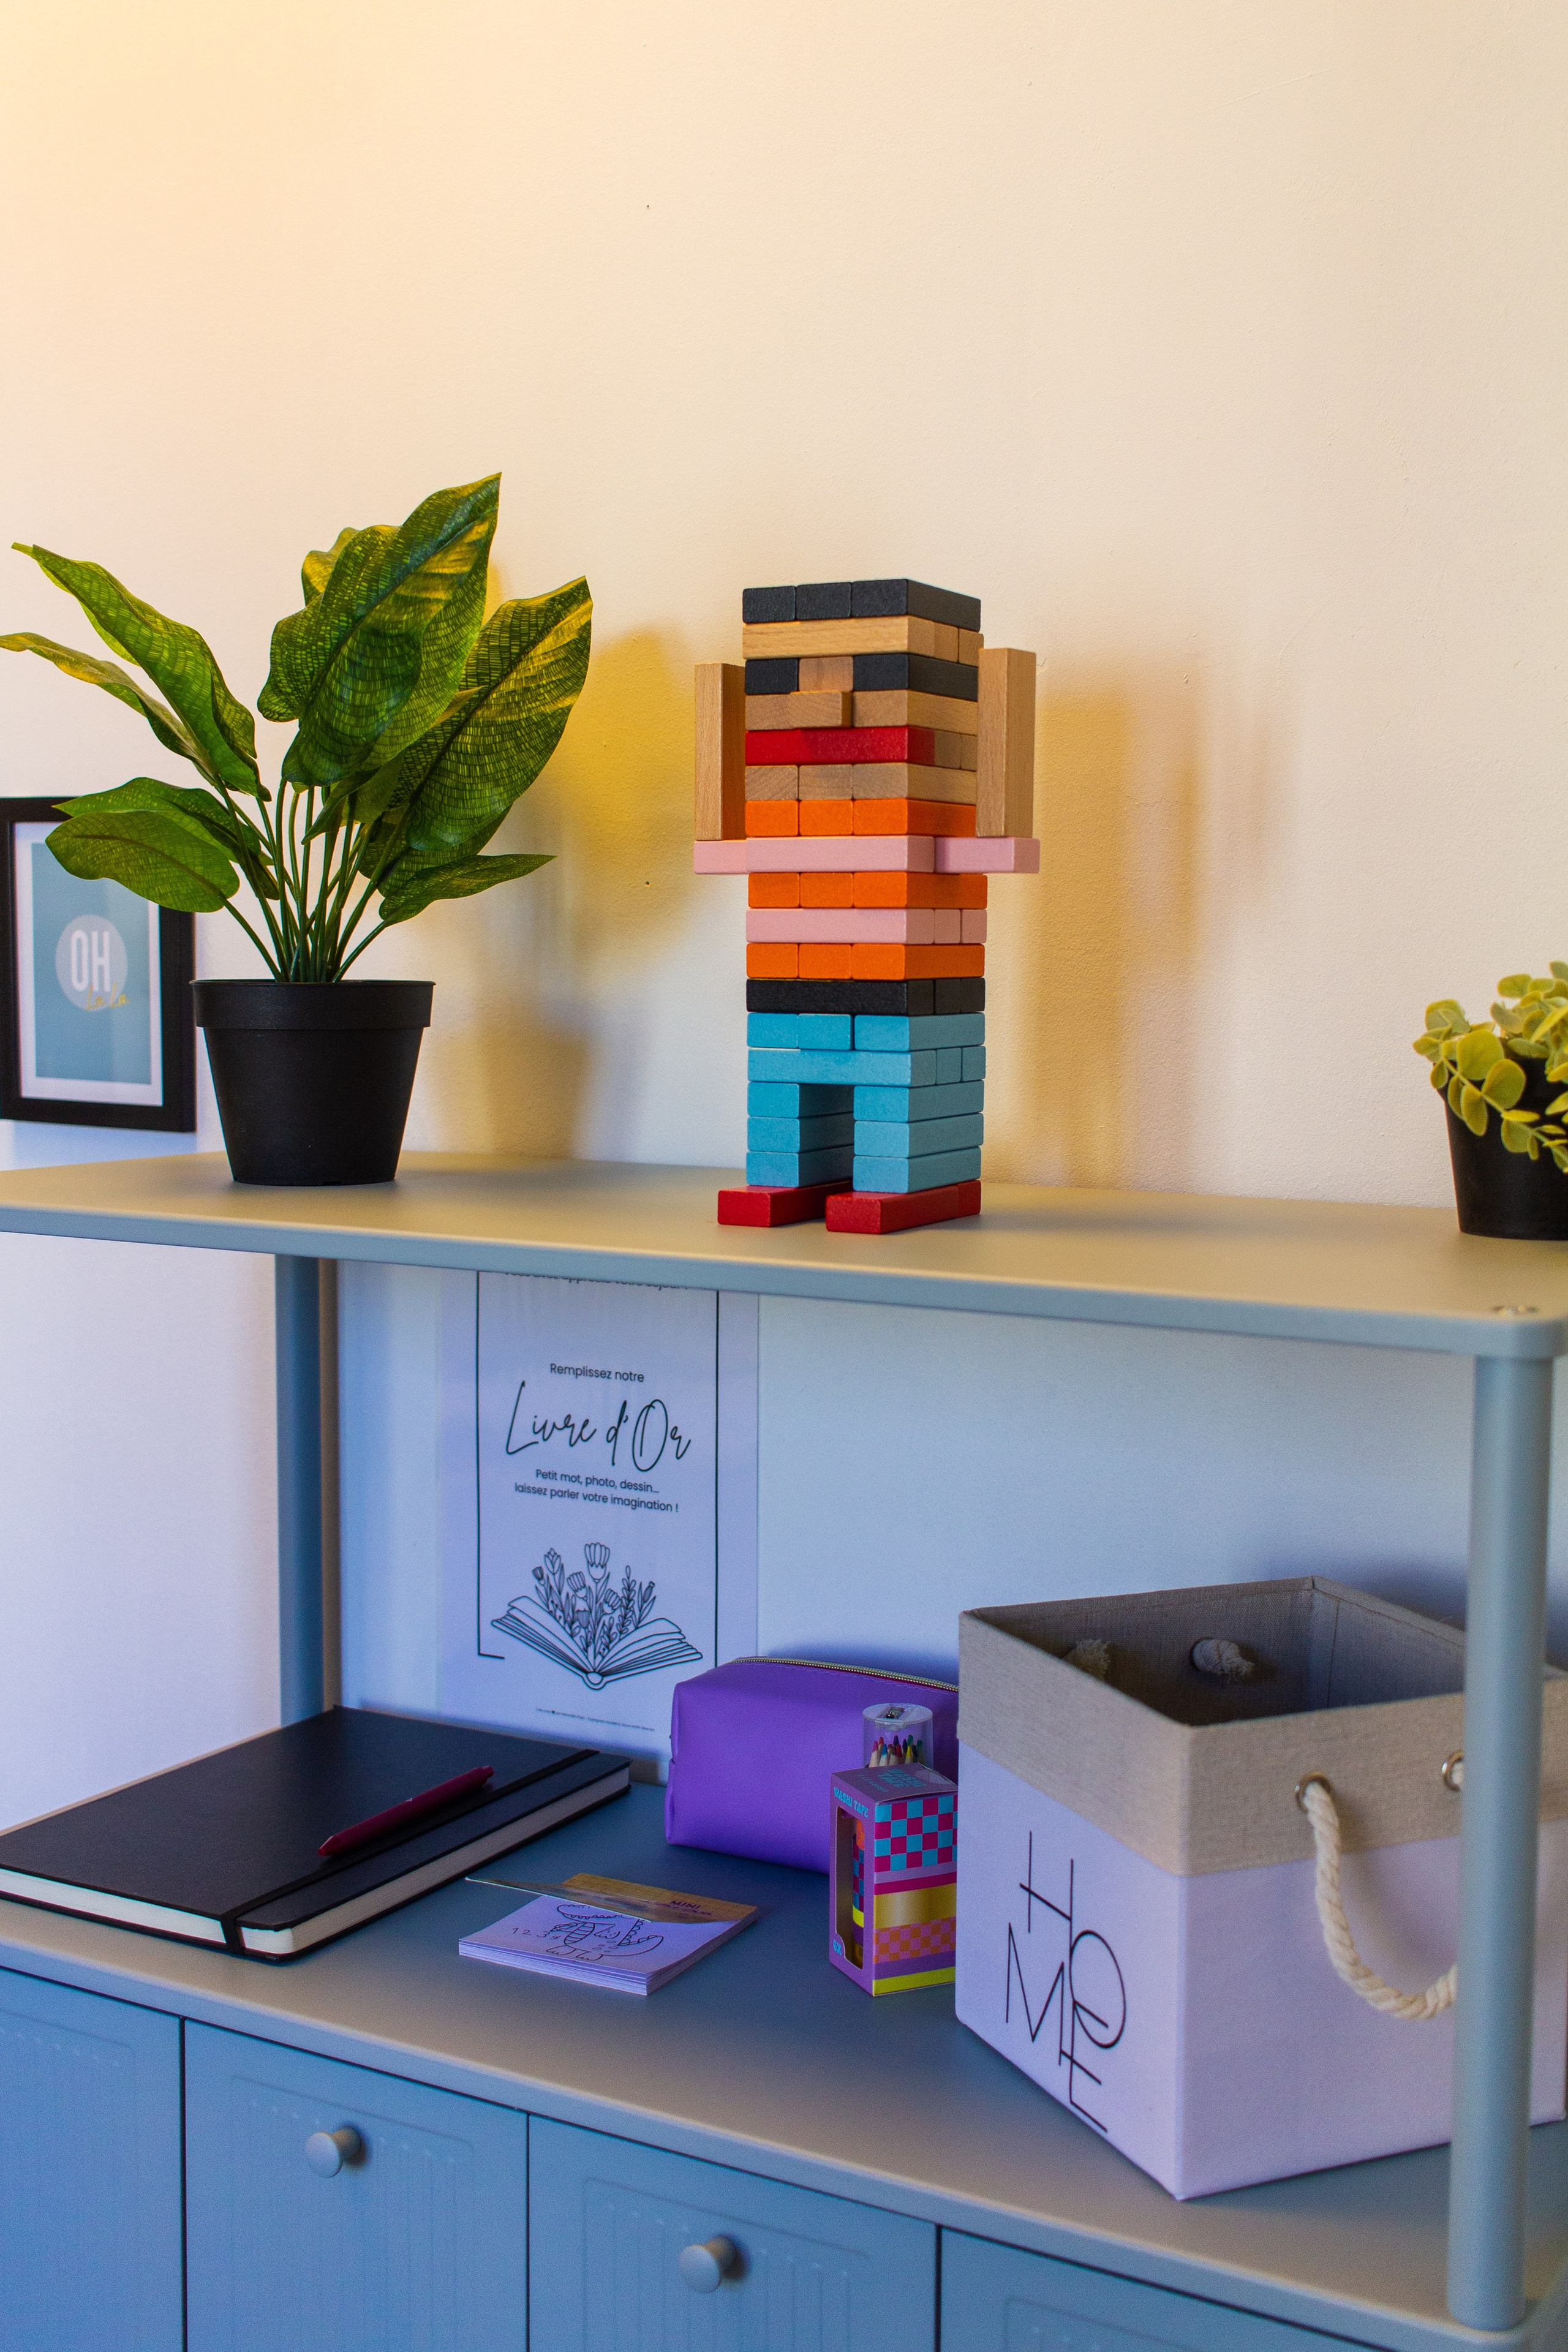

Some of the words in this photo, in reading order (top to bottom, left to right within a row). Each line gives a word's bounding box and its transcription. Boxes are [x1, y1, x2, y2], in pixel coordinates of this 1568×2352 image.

[70, 929, 110, 992] OH
[550, 1363, 612, 1379] Remplissez
[615, 1371, 645, 1382] notre
[506, 1380, 597, 1455] Livre
[606, 1399, 692, 1472] d'Or
[536, 1469, 558, 1480] Petit
[560, 1472, 582, 1485] mot,
[585, 1476, 617, 1489] photo,
[515, 1482, 548, 1496] laissez
[550, 1487, 579, 1499] parler
[582, 1491, 608, 1504] votre
[611, 1494, 673, 1512] imagination
[834, 1786, 853, 1807] WASHI
[854, 1800, 869, 1819] TAPE
